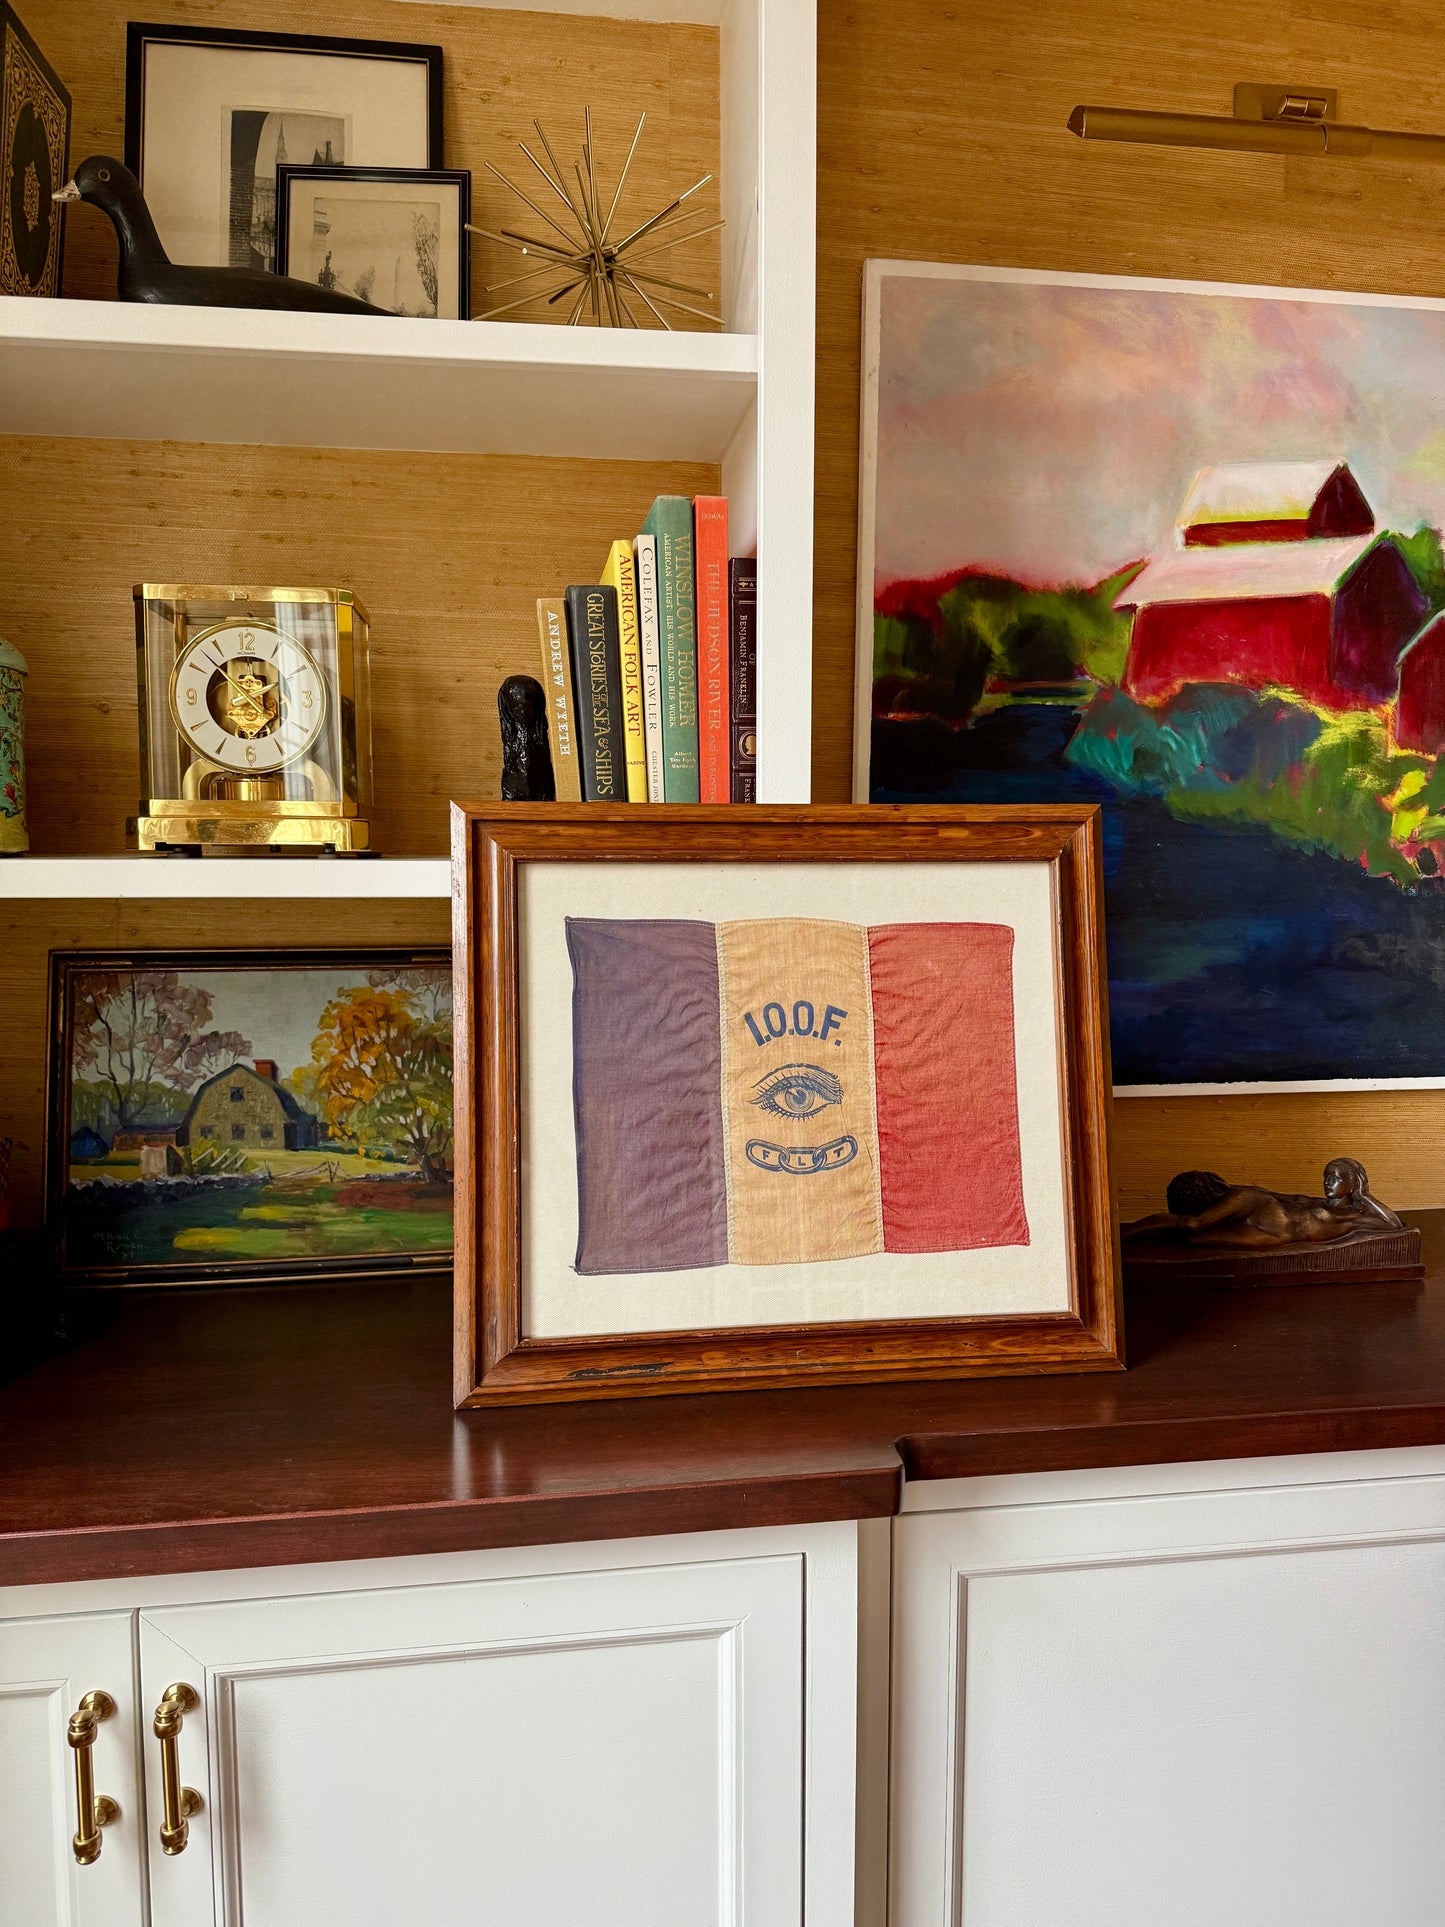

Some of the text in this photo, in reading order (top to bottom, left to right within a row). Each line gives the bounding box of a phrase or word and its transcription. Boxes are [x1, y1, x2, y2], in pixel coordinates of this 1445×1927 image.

[664, 533, 672, 577] AMERICAN
[642, 547, 654, 623] COLEFAX
[707, 563, 720, 592] THE
[586, 593, 605, 640] GREAT
[666, 615, 674, 630] HIS
[674, 533, 696, 727] WINSLOW HOMER
[707, 600, 721, 674] HUDSON
[239, 631, 256, 651] 12
[619, 554, 641, 737] AMERICAN FOLK ART
[667, 633, 675, 661] WORLD
[739, 615, 748, 704] BENJAMIN FRANKLIN
[547, 611, 571, 756] ANDREW WYETH
[588, 641, 609, 692] STORIES
[667, 665, 675, 685] AND
[185, 688, 198, 706] 9
[301, 690, 313, 709] 3
[647, 664, 658, 730] FOWLER
[668, 703, 676, 727] WORK
[708, 679, 721, 729] RIVER
[592, 708, 611, 737] SEA
[597, 737, 609, 750] &
[245, 746, 257, 764] 6
[595, 750, 614, 796] SHIPS
[743, 1000, 848, 1047] I.O.O.F.
[762, 1147, 844, 1166] F L T
